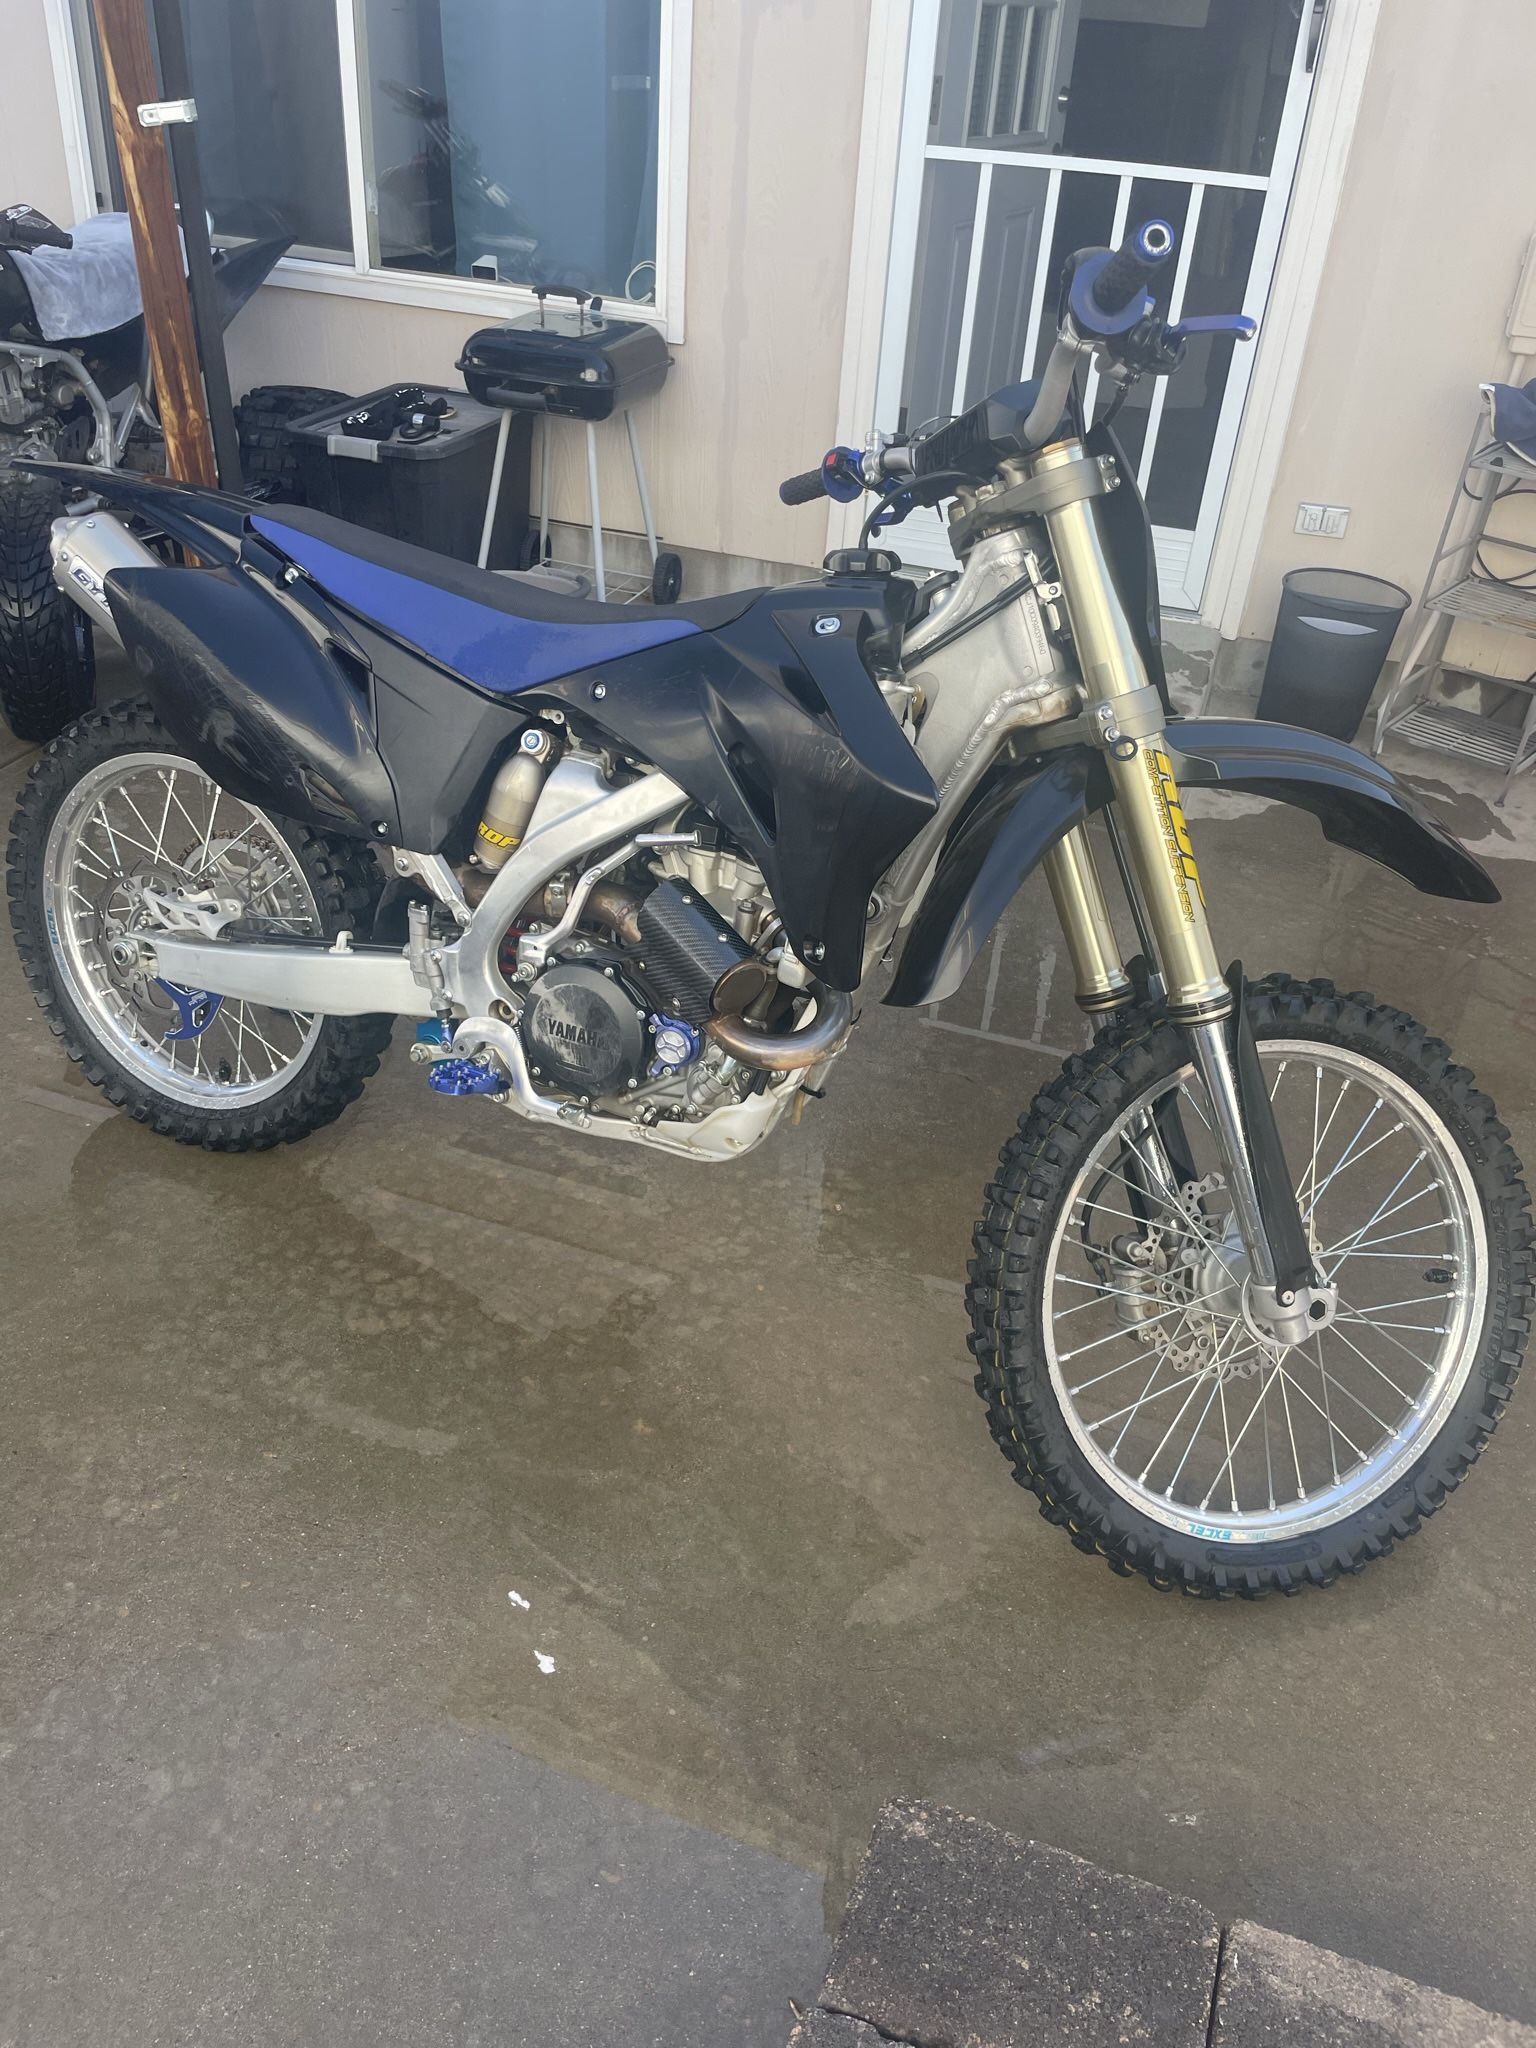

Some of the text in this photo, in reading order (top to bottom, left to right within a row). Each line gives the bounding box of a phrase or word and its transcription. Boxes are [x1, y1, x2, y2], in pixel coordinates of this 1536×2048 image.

[72, 568, 109, 607] GY
[1143, 749, 1195, 922] COMPETITION SUSPENSION
[547, 1018, 609, 1051] YAMAHA
[1188, 1523, 1233, 1541] EXCEL
